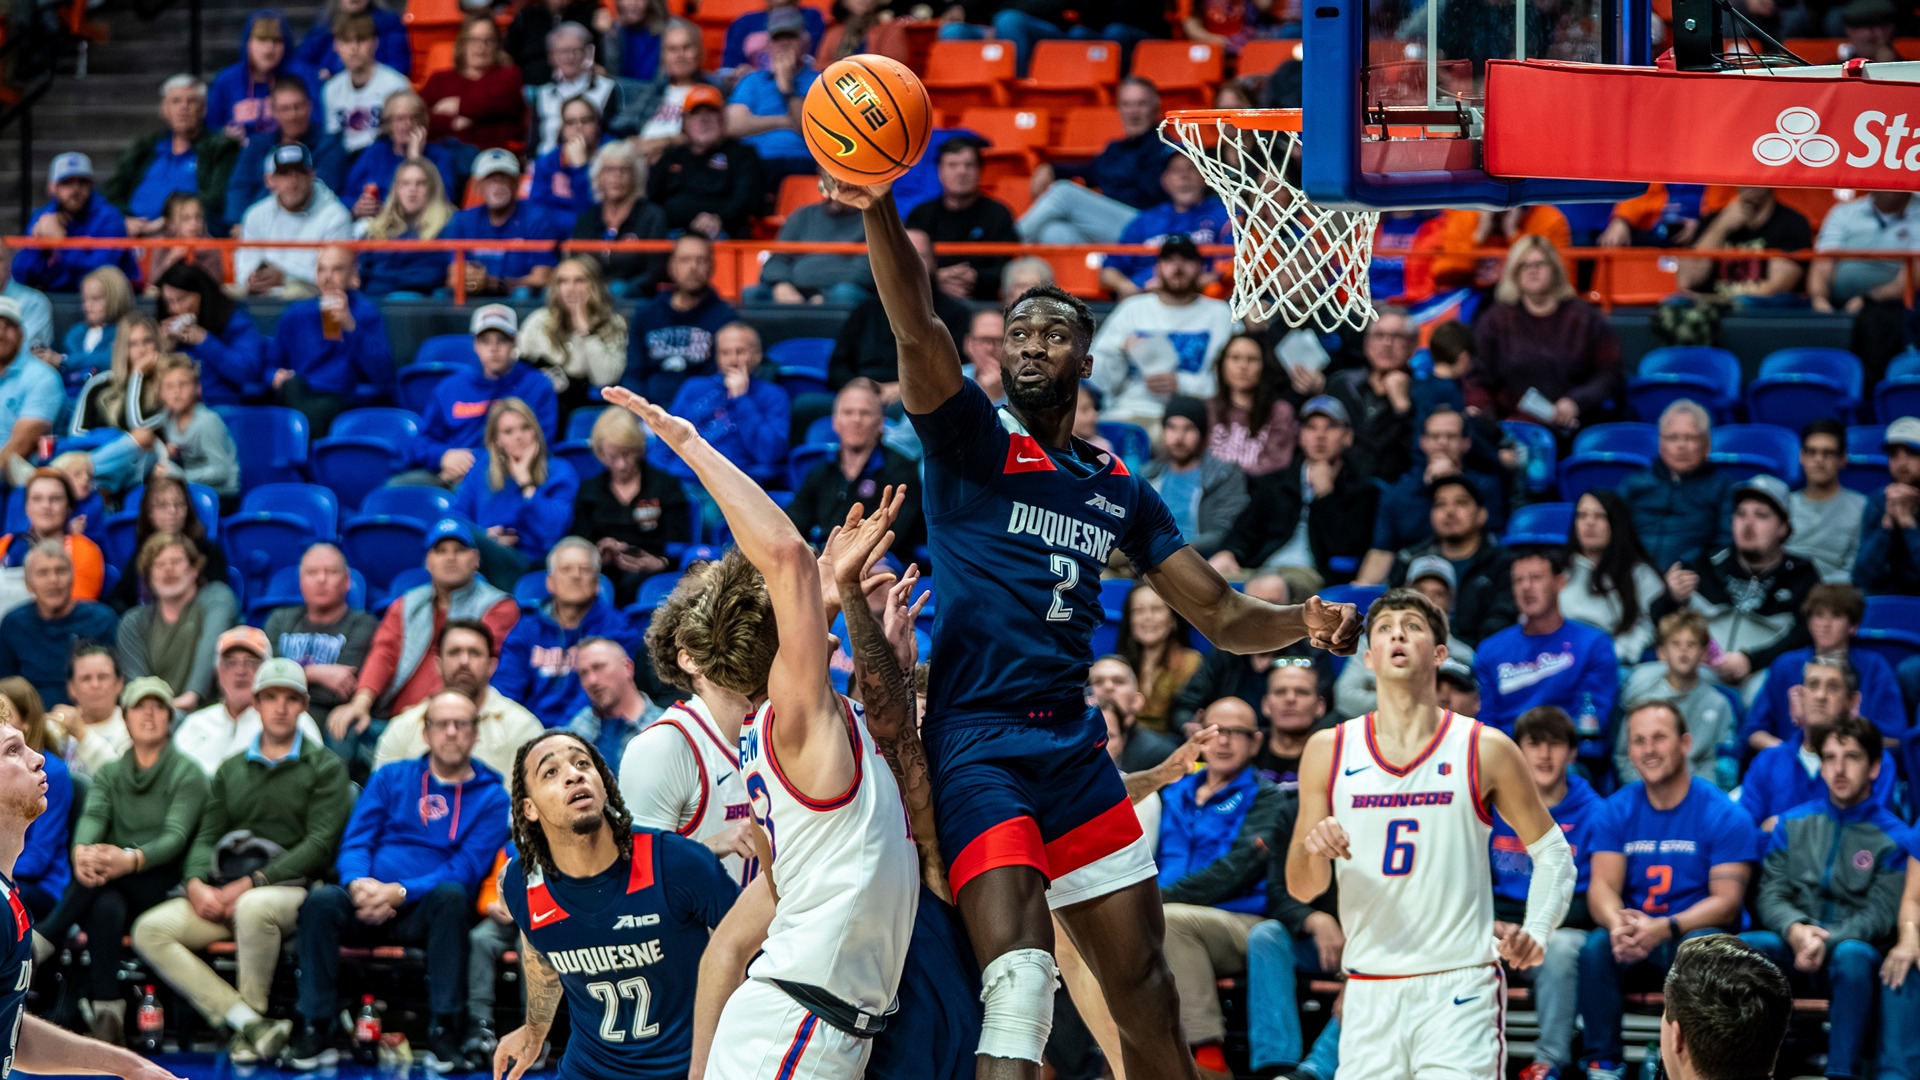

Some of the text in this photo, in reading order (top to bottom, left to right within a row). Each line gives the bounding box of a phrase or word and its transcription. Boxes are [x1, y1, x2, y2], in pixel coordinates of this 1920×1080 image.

[835, 72, 889, 132] ELITE
[1007, 501, 1116, 564] DUQUESNE
[1085, 492, 1126, 519] A10
[1046, 552, 1080, 621] 2
[1351, 790, 1454, 809] BRONCOS
[1382, 818, 1420, 877] 6
[1642, 864, 1673, 914] 2
[612, 913, 661, 930] A10
[547, 939, 664, 976] DUQUESNE
[586, 975, 660, 1042] 22
